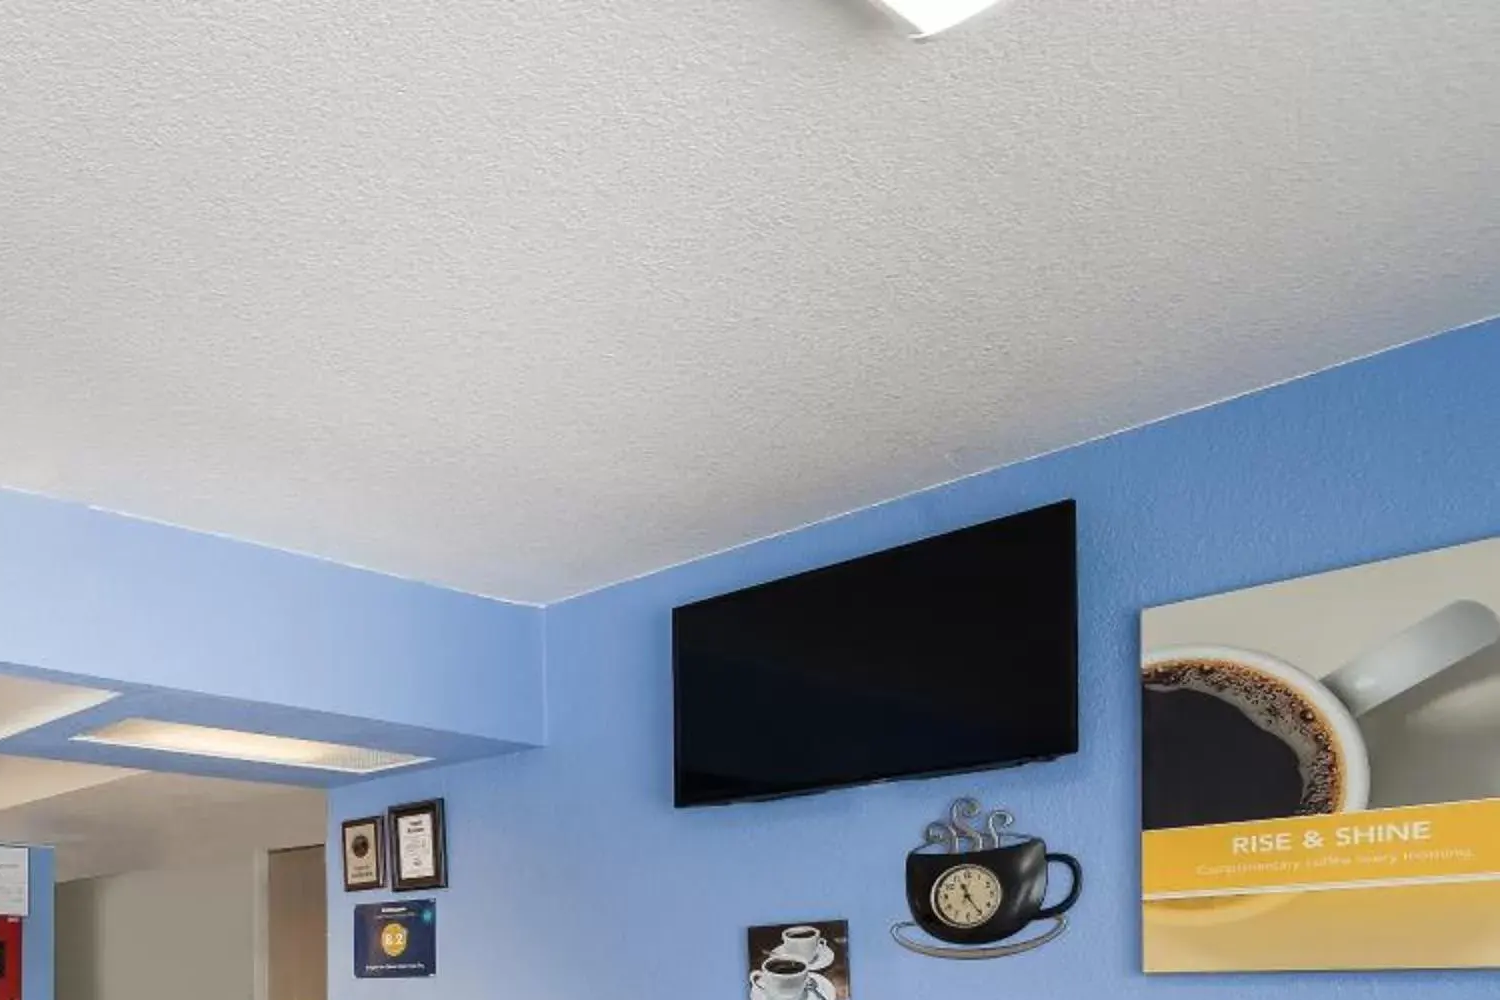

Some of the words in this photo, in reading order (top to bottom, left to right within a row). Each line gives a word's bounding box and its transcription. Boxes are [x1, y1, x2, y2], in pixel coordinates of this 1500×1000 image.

[1232, 833, 1292, 855] RISE
[1302, 829, 1324, 849] &
[1335, 820, 1432, 847] SHINE
